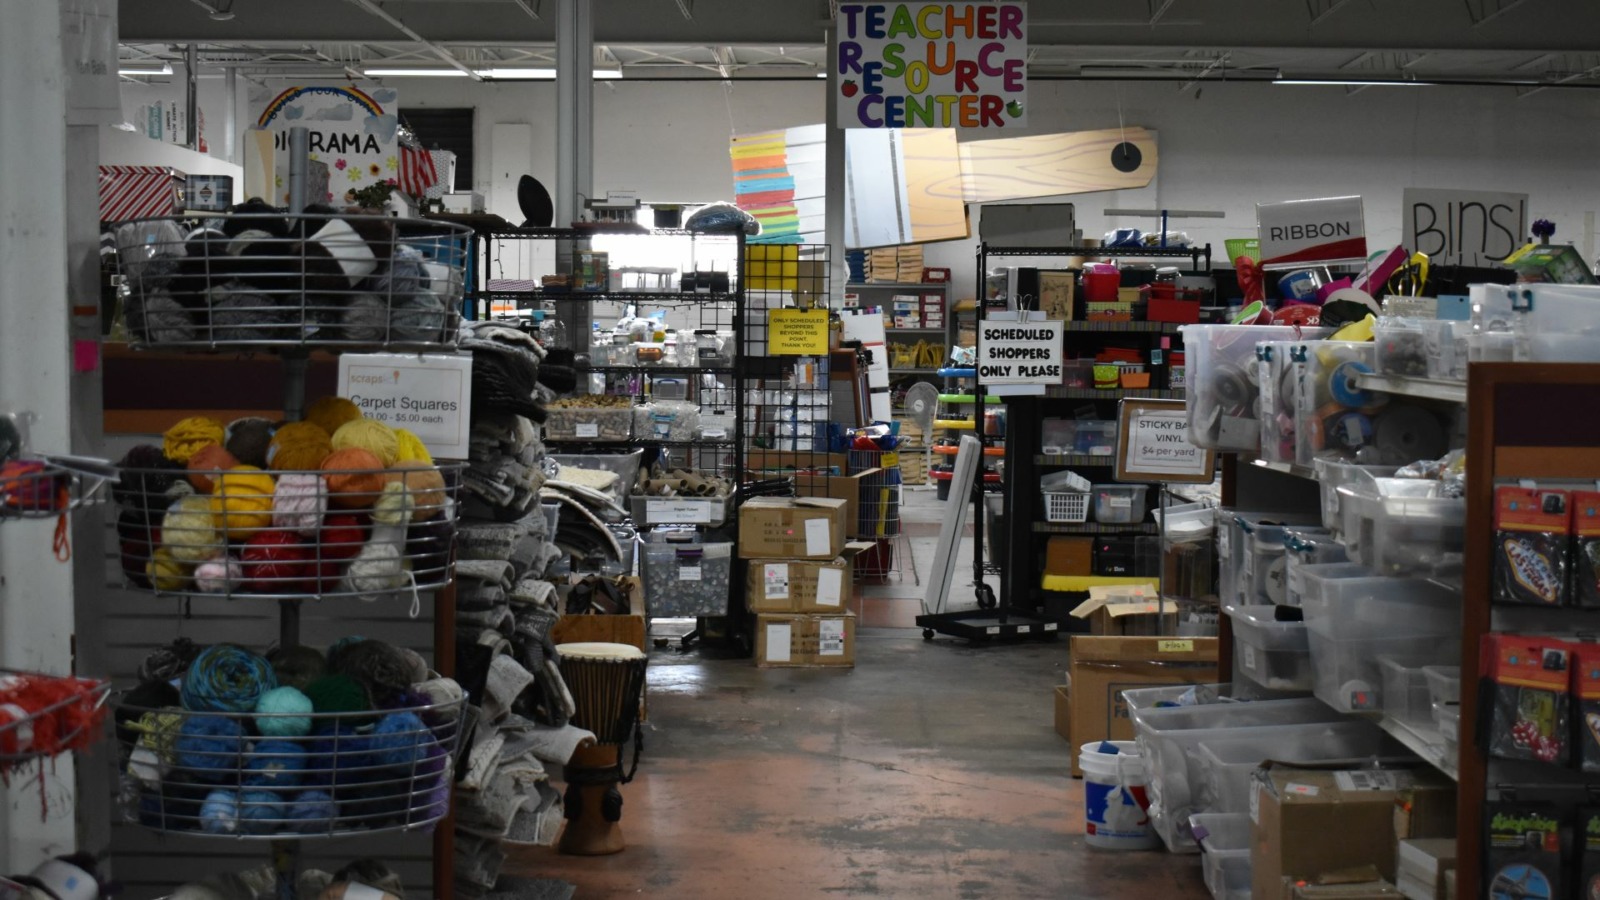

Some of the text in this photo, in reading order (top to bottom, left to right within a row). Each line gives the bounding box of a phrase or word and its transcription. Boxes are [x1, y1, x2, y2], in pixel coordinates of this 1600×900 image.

[840, 4, 1023, 39] TEACHER
[839, 41, 1024, 94] RESOURCE
[857, 94, 1005, 128] CENTER
[275, 131, 381, 154] IRAMA
[1270, 221, 1350, 242] RIBBON
[984, 328, 1054, 341] SCHEDULED
[989, 347, 1051, 360] SHOPPERS
[980, 365, 1060, 377] ONLY PLEASE
[351, 395, 458, 412] Carpet Squares
[363, 412, 388, 421] $300
[396, 412, 420, 422] $5.00
[422, 414, 443, 424] each
[1139, 420, 1173, 429] STICKY
[1156, 434, 1184, 443] VINYL
[1142, 446, 1195, 457] $4 per yard
